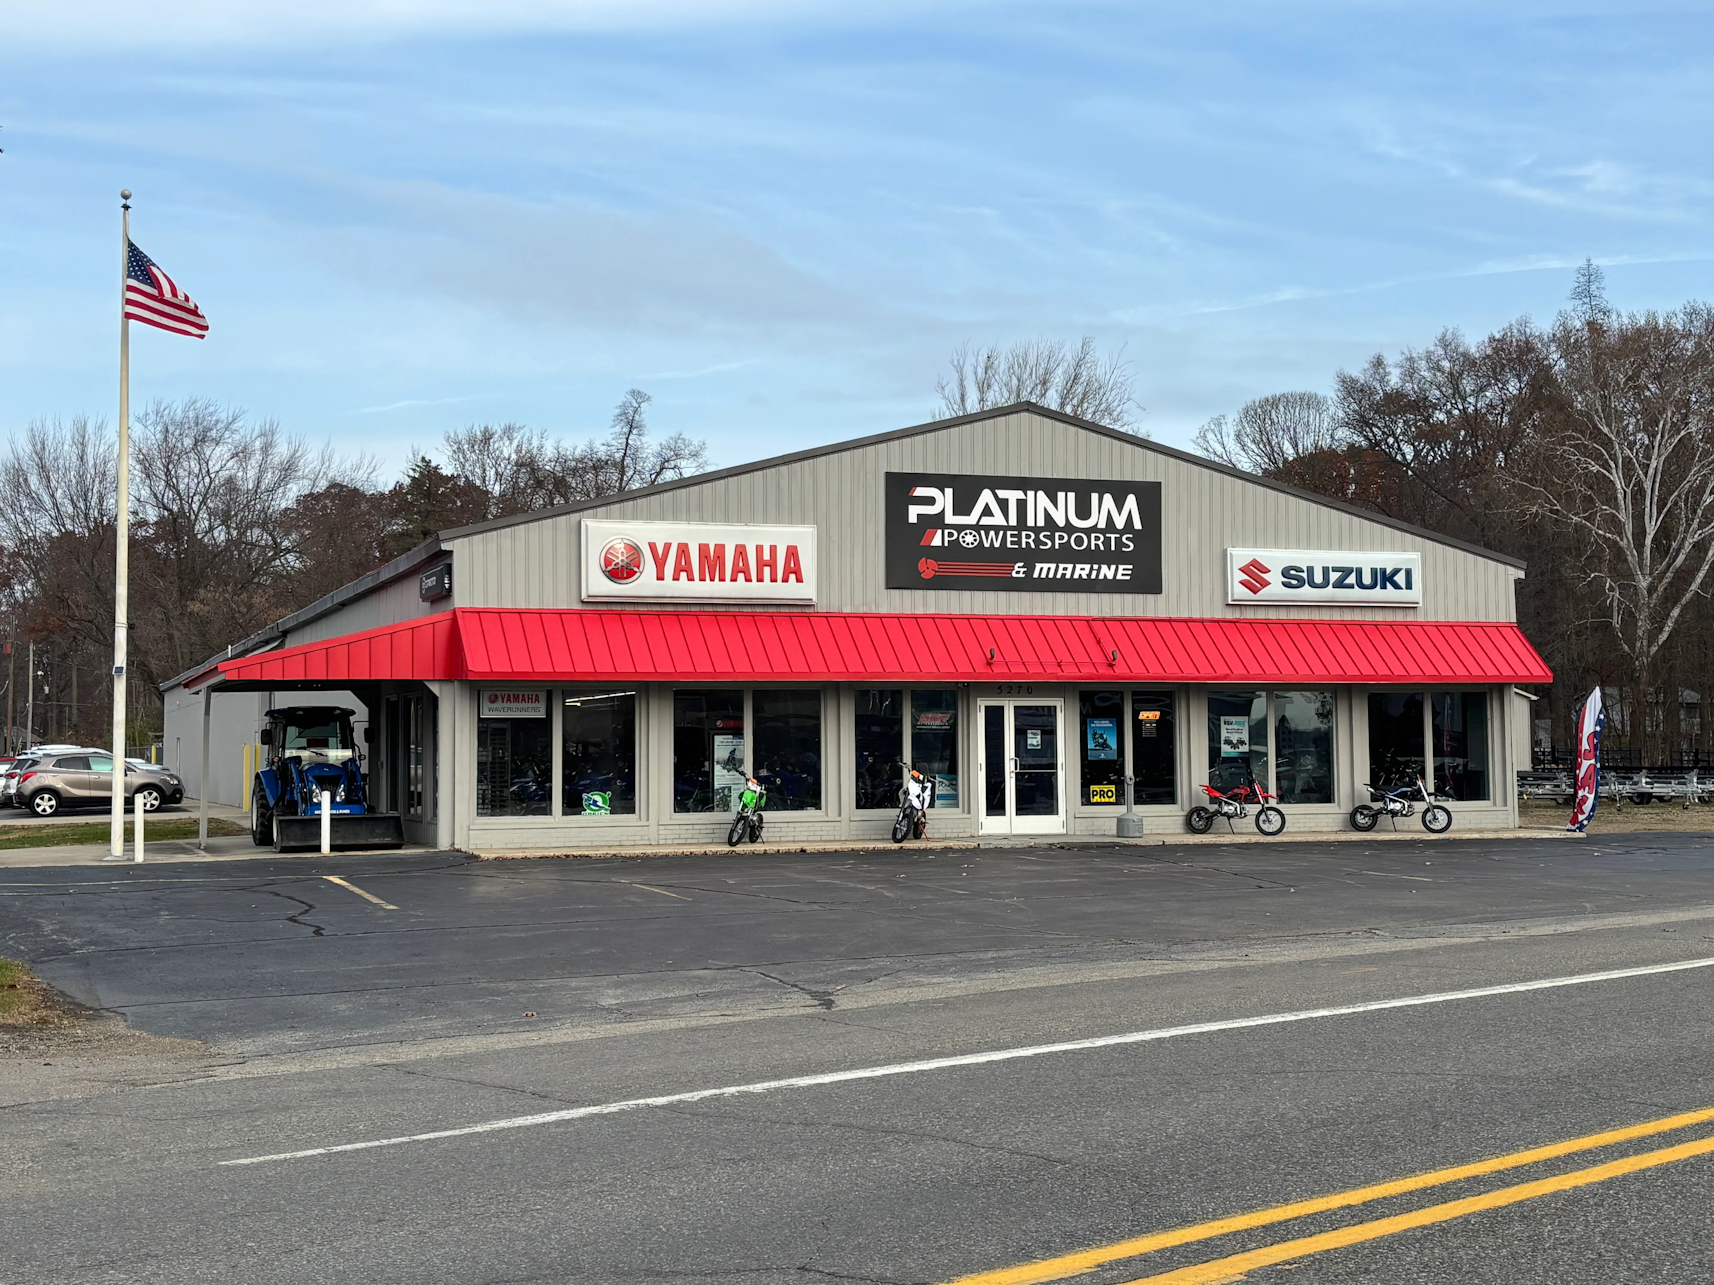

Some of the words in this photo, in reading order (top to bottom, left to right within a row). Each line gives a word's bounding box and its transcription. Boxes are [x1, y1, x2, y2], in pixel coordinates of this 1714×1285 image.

[908, 486, 1143, 531] PLATINUM
[944, 529, 1135, 552] POWERSPORTS
[647, 541, 805, 584] YAMAHA
[1011, 562, 1028, 578] &
[1280, 565, 1413, 591] SUZUKI
[500, 693, 540, 704] YAMAHA
[997, 685, 1033, 695] 5270
[1091, 789, 1114, 799] PRO
